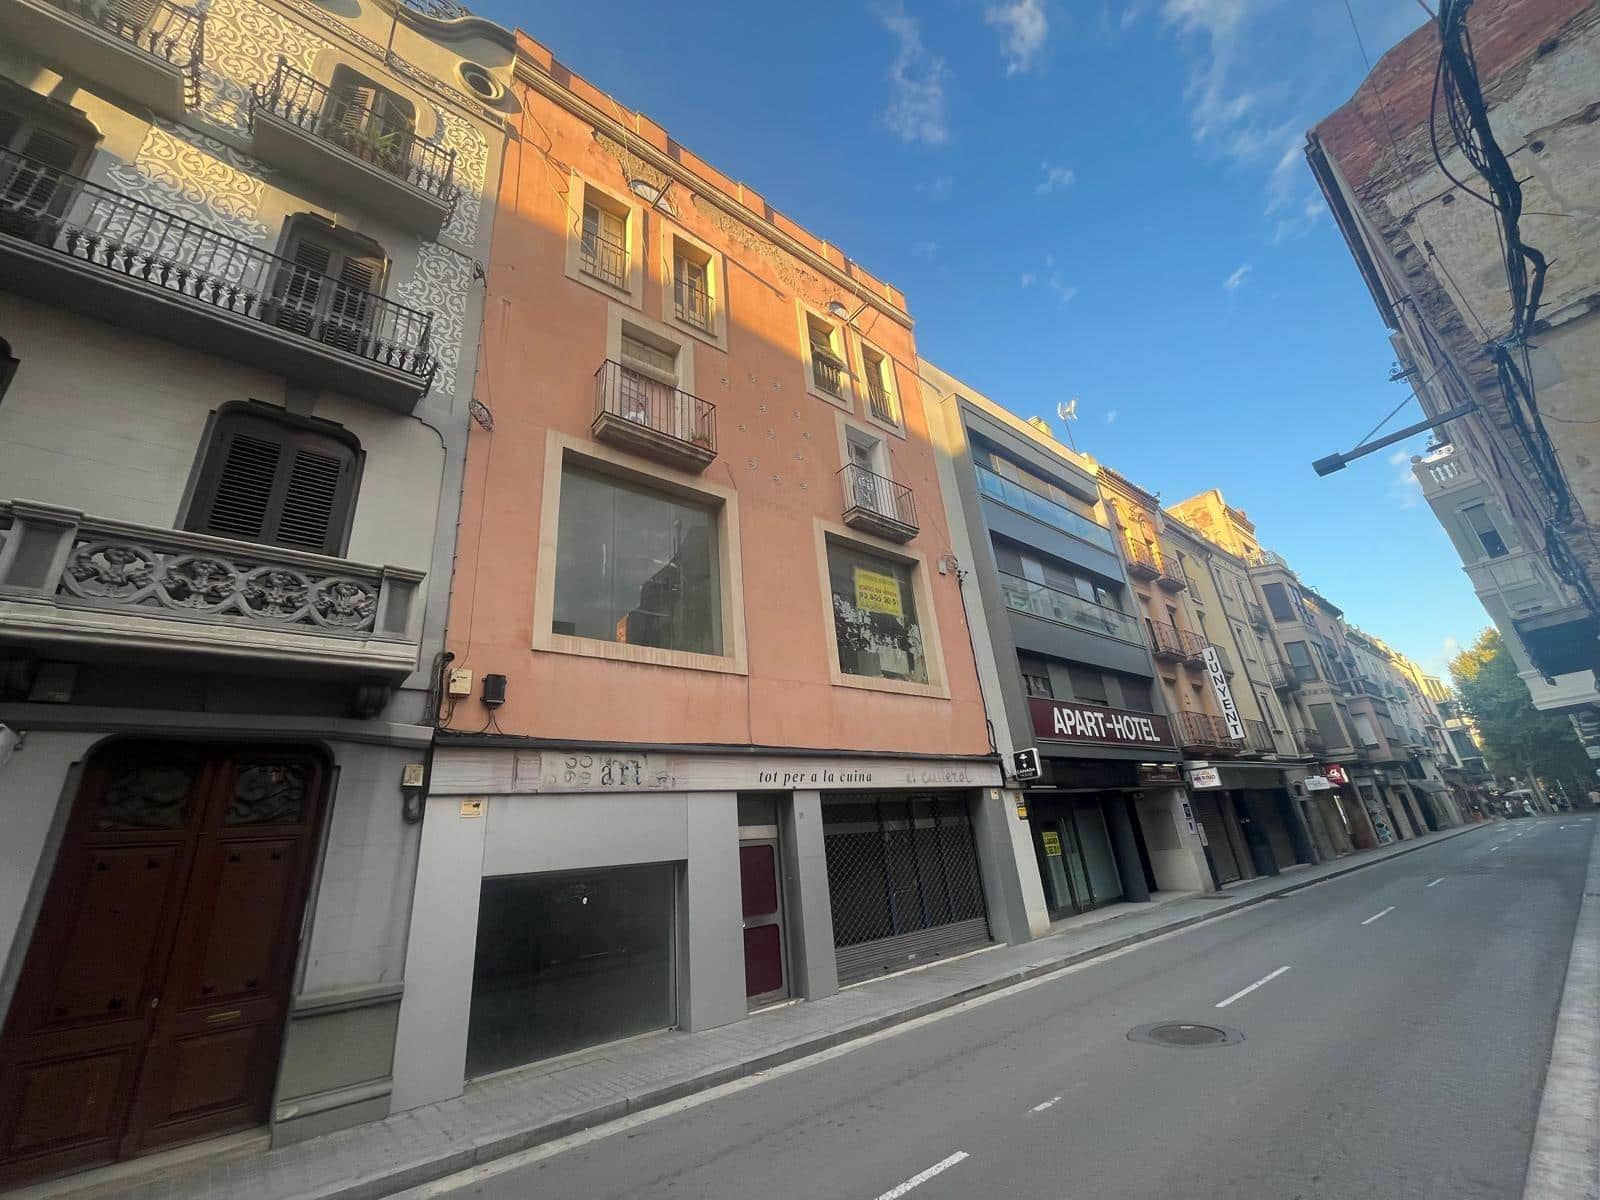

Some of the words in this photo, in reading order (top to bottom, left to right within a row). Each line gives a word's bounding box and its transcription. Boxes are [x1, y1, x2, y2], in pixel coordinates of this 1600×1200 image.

[1208, 651, 1239, 735] JUNYENT
[1053, 707, 1161, 742] APART-HOTEL
[601, 761, 642, 786] art
[759, 770, 778, 783] tot
[783, 771, 805, 786] per
[811, 774, 817, 782] a
[823, 769, 834, 782] la
[839, 770, 873, 782] cuina
